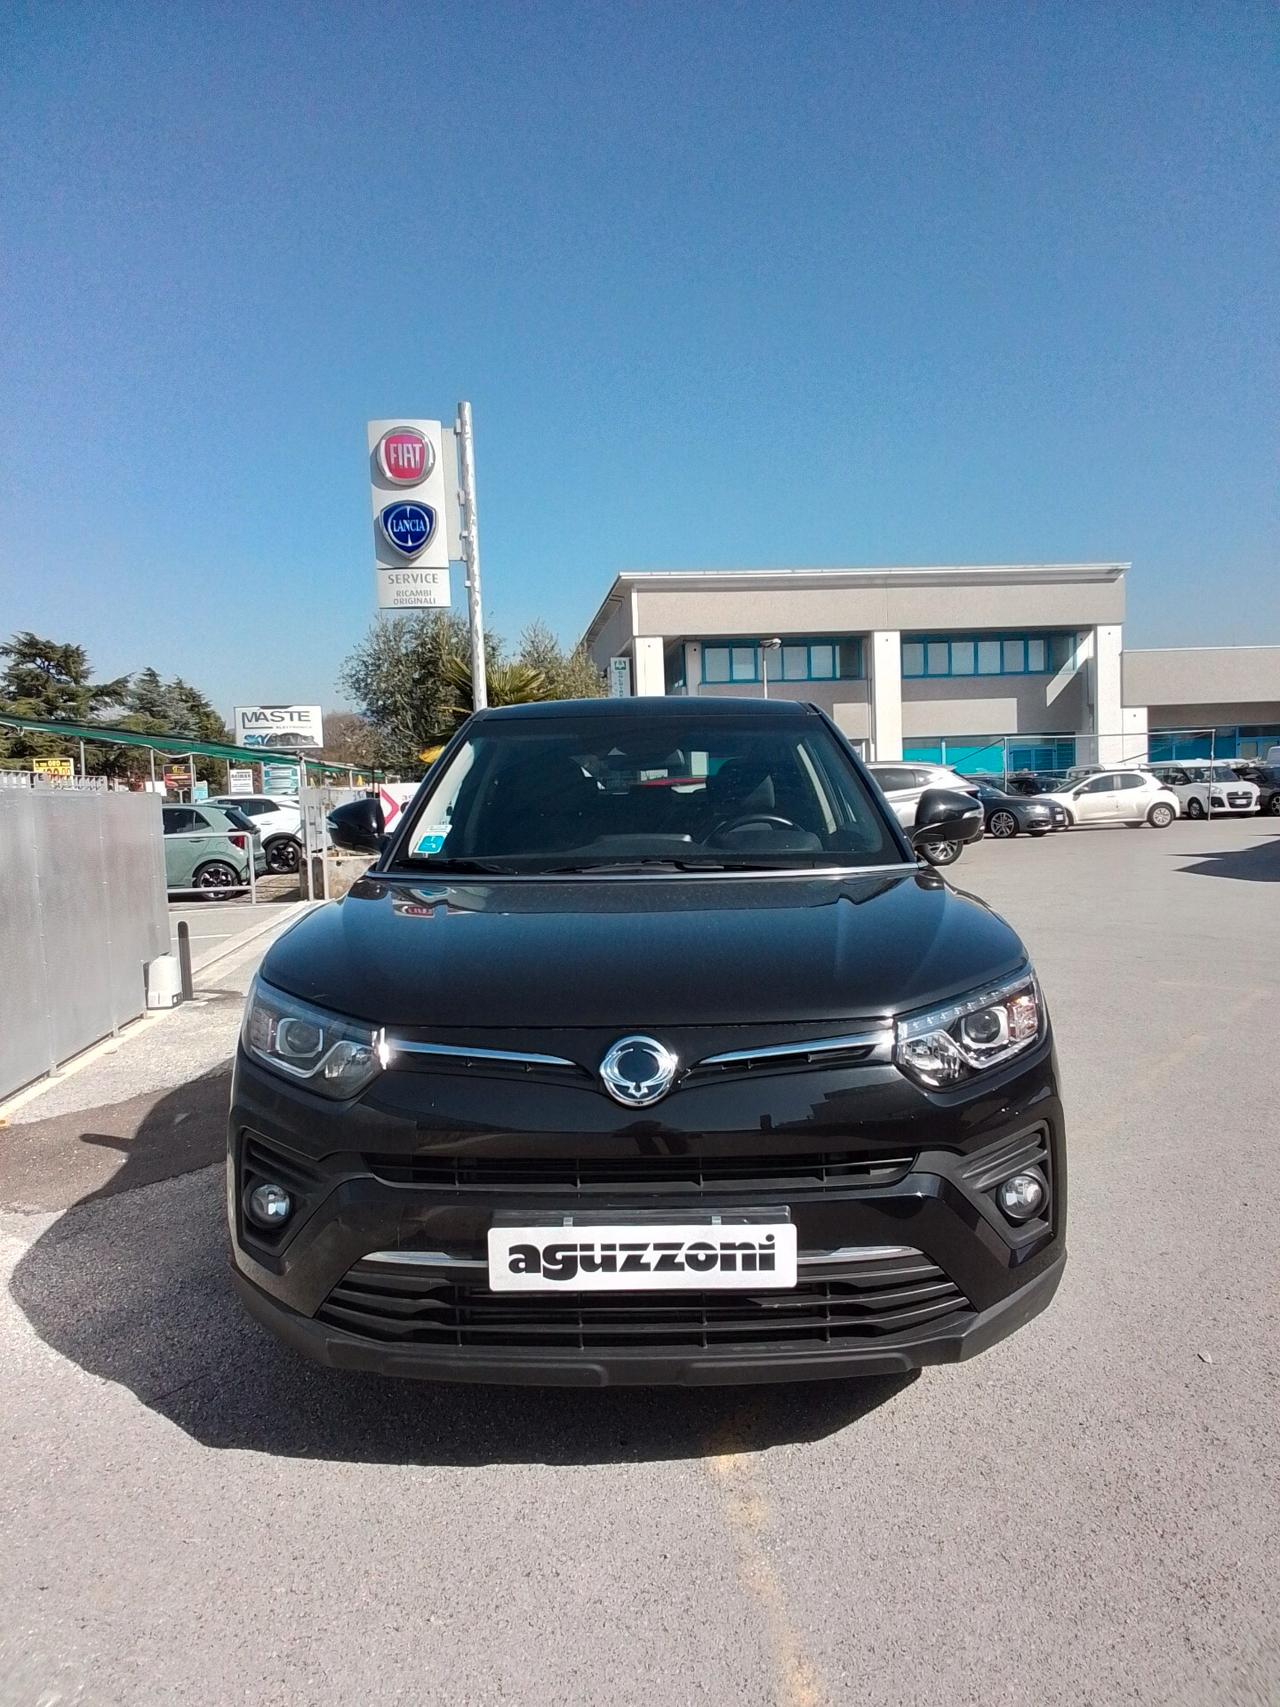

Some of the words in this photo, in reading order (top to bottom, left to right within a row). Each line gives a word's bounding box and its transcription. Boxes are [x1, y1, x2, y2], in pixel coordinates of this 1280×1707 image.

[389, 443, 423, 469] FIAT
[393, 518, 426, 533] LANCIA
[388, 573, 439, 584] SERVICE
[396, 589, 432, 598] RICAMBI
[394, 598, 436, 606] ORIGINALI
[241, 710, 312, 723] MASTE
[508, 1234, 775, 1281] aguzzoni
